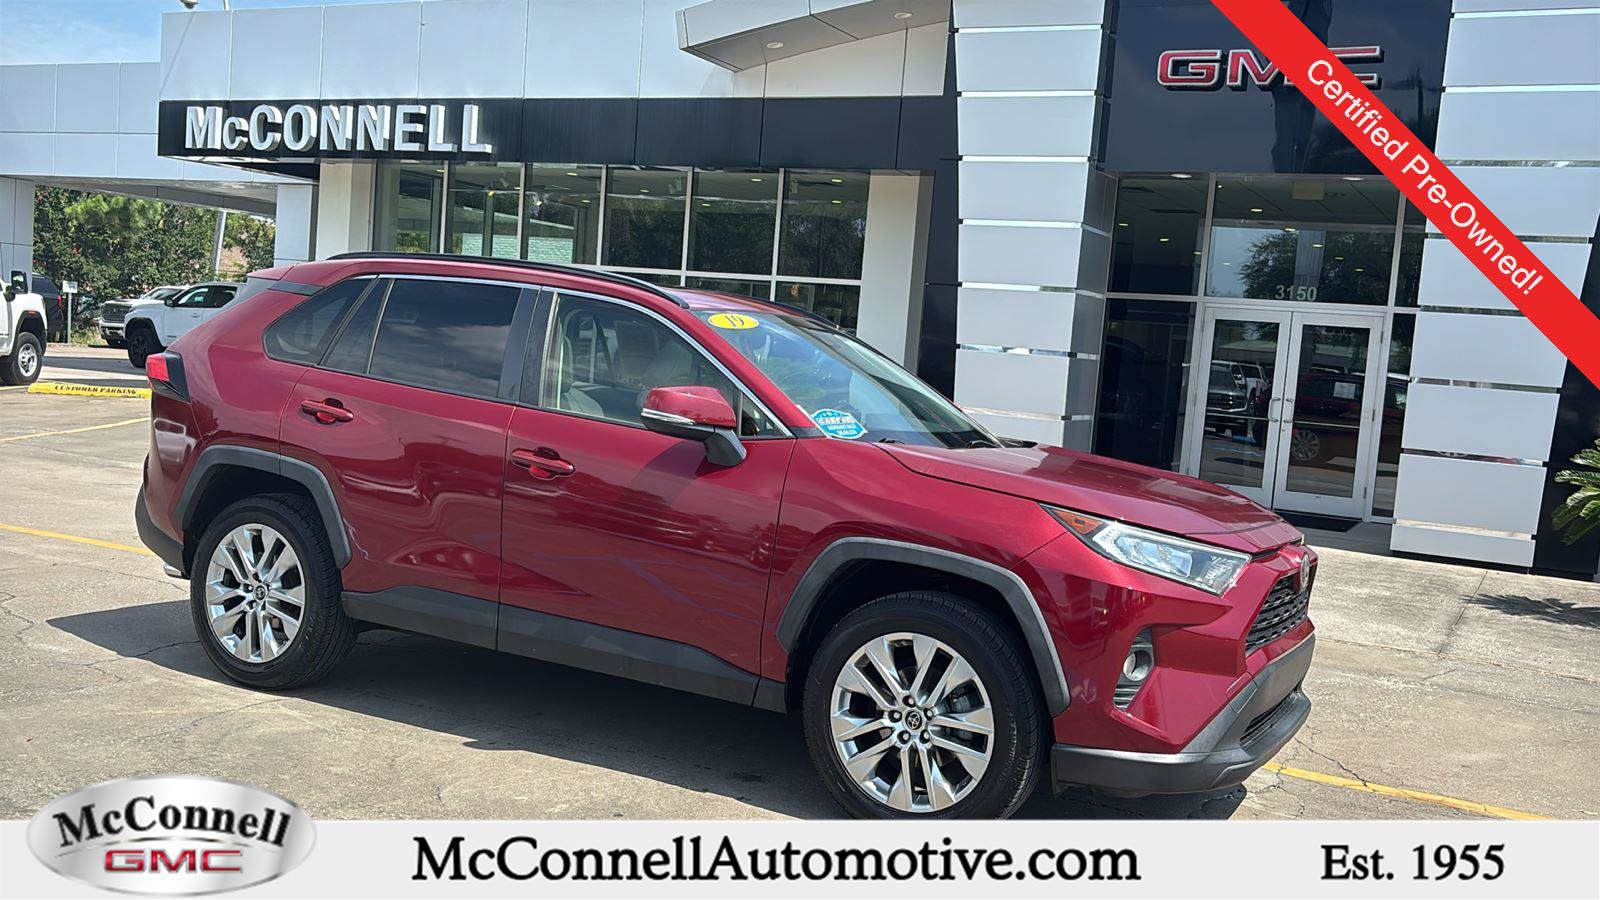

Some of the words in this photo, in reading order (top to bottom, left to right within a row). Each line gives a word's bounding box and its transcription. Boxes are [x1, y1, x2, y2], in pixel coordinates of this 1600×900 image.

[185, 104, 493, 153] McCONNELL
[1274, 284, 1318, 302] 3150
[99, 387, 137, 395] PARKING
